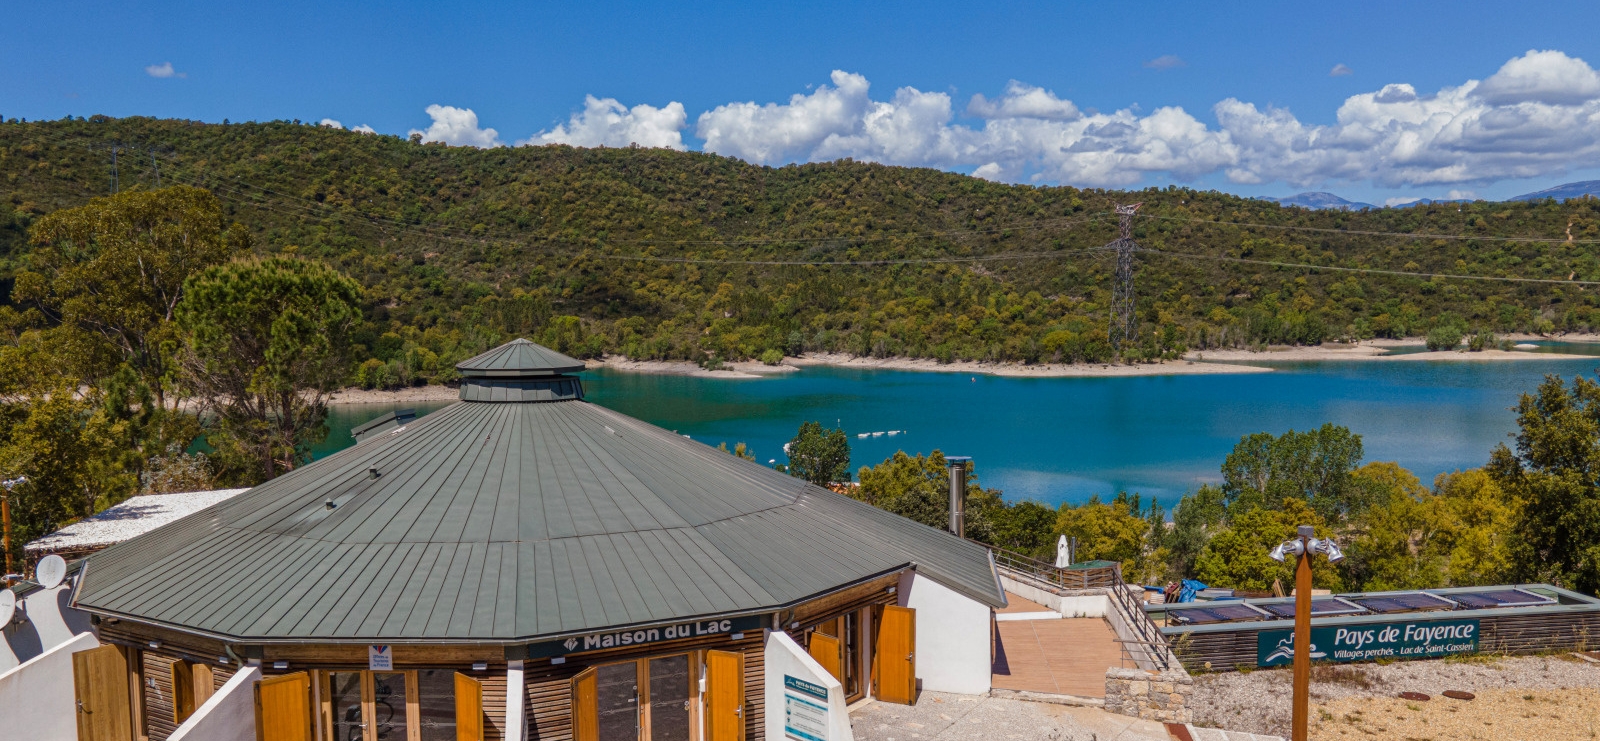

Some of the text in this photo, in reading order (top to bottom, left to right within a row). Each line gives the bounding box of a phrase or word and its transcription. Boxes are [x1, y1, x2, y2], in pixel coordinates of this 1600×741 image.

[584, 619, 732, 650] Maison du Lac
[1334, 624, 1475, 649] Pays de Fayence
[1334, 649, 1364, 660] Villages
[1364, 647, 1394, 659] perchés
[1400, 646, 1413, 655] Lac
[1414, 645, 1424, 654] de
[1425, 643, 1474, 653] Saint-Cassien
